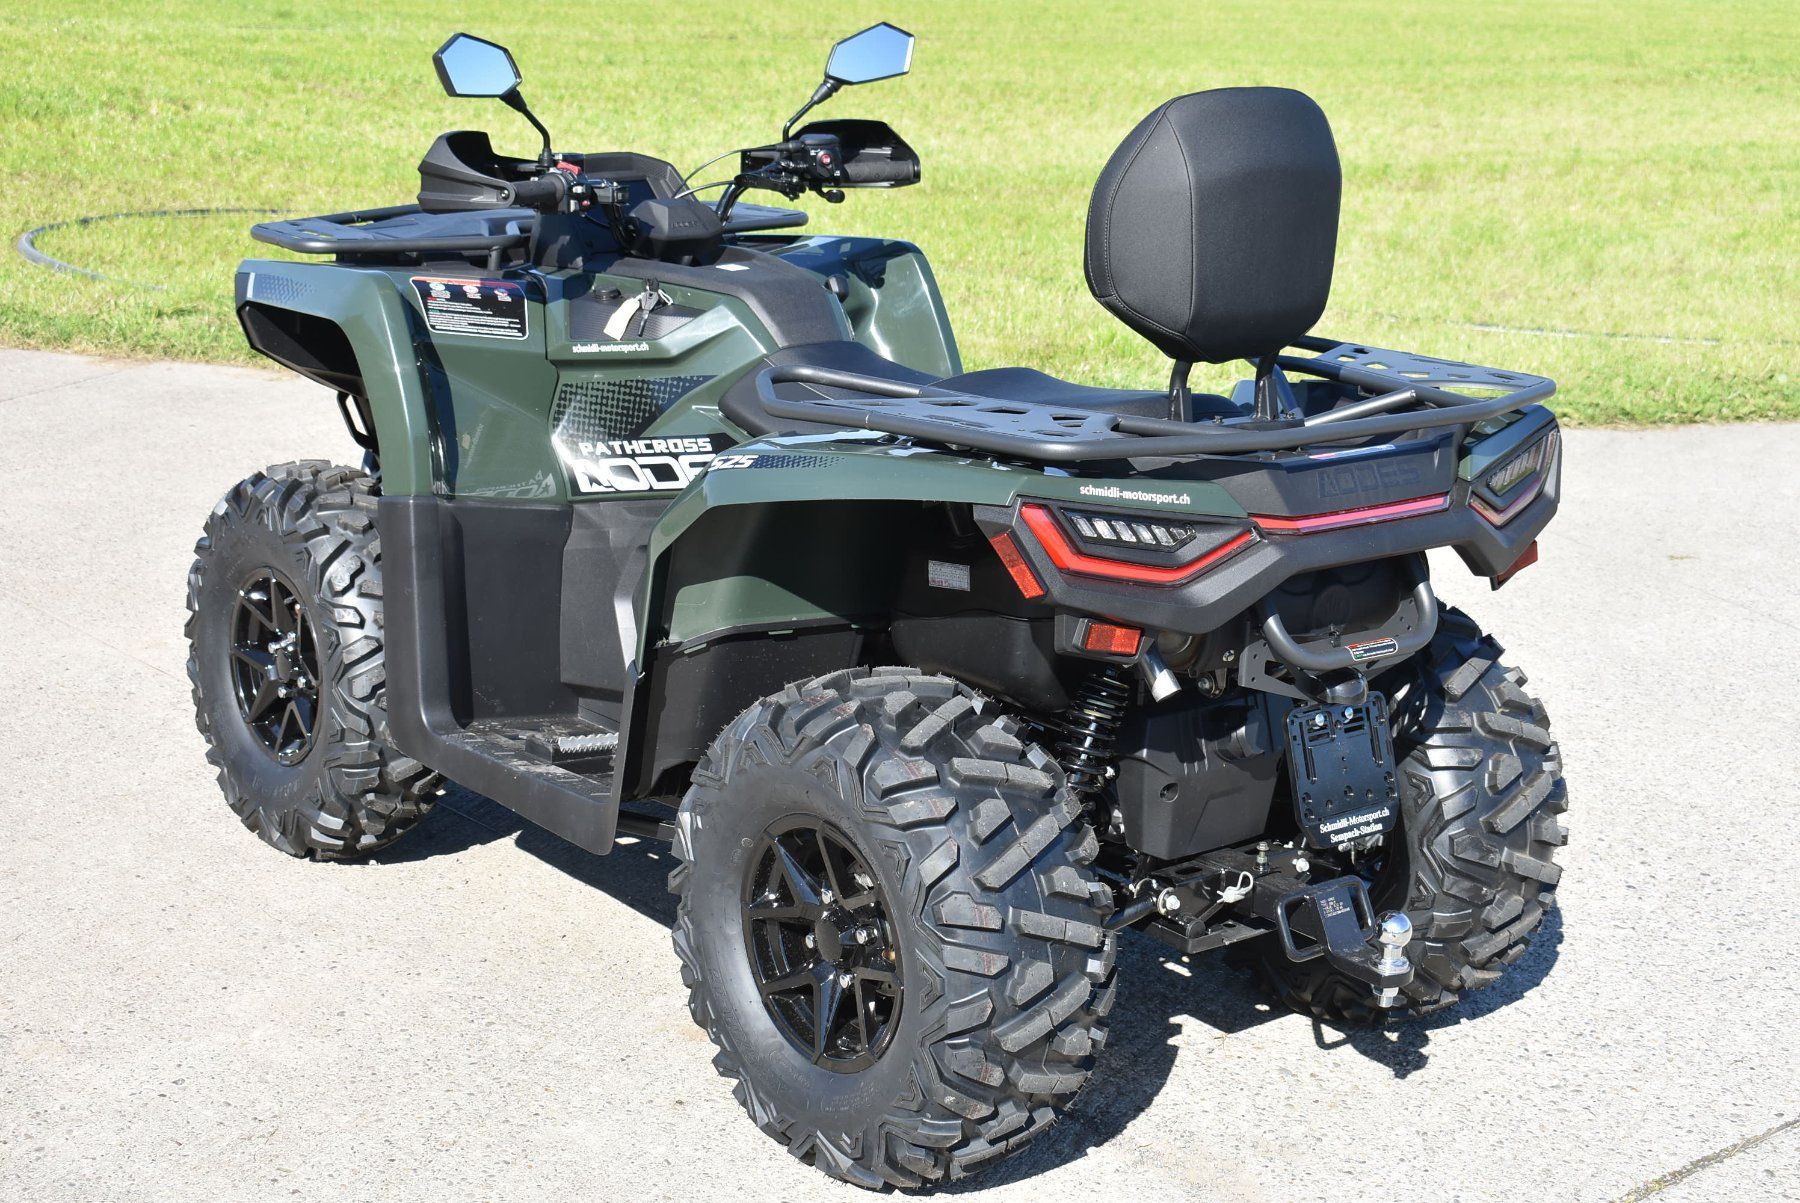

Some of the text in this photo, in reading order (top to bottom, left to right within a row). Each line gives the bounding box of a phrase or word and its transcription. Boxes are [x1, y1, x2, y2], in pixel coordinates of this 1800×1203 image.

[578, 437, 713, 456] PATHCROSS
[708, 454, 760, 472] 525
[1079, 484, 1191, 505] schmidli-motorsport.ch
[1319, 806, 1391, 834] Schmidli-Motorsport.ch
[1329, 822, 1384, 844] Sempach-Station
